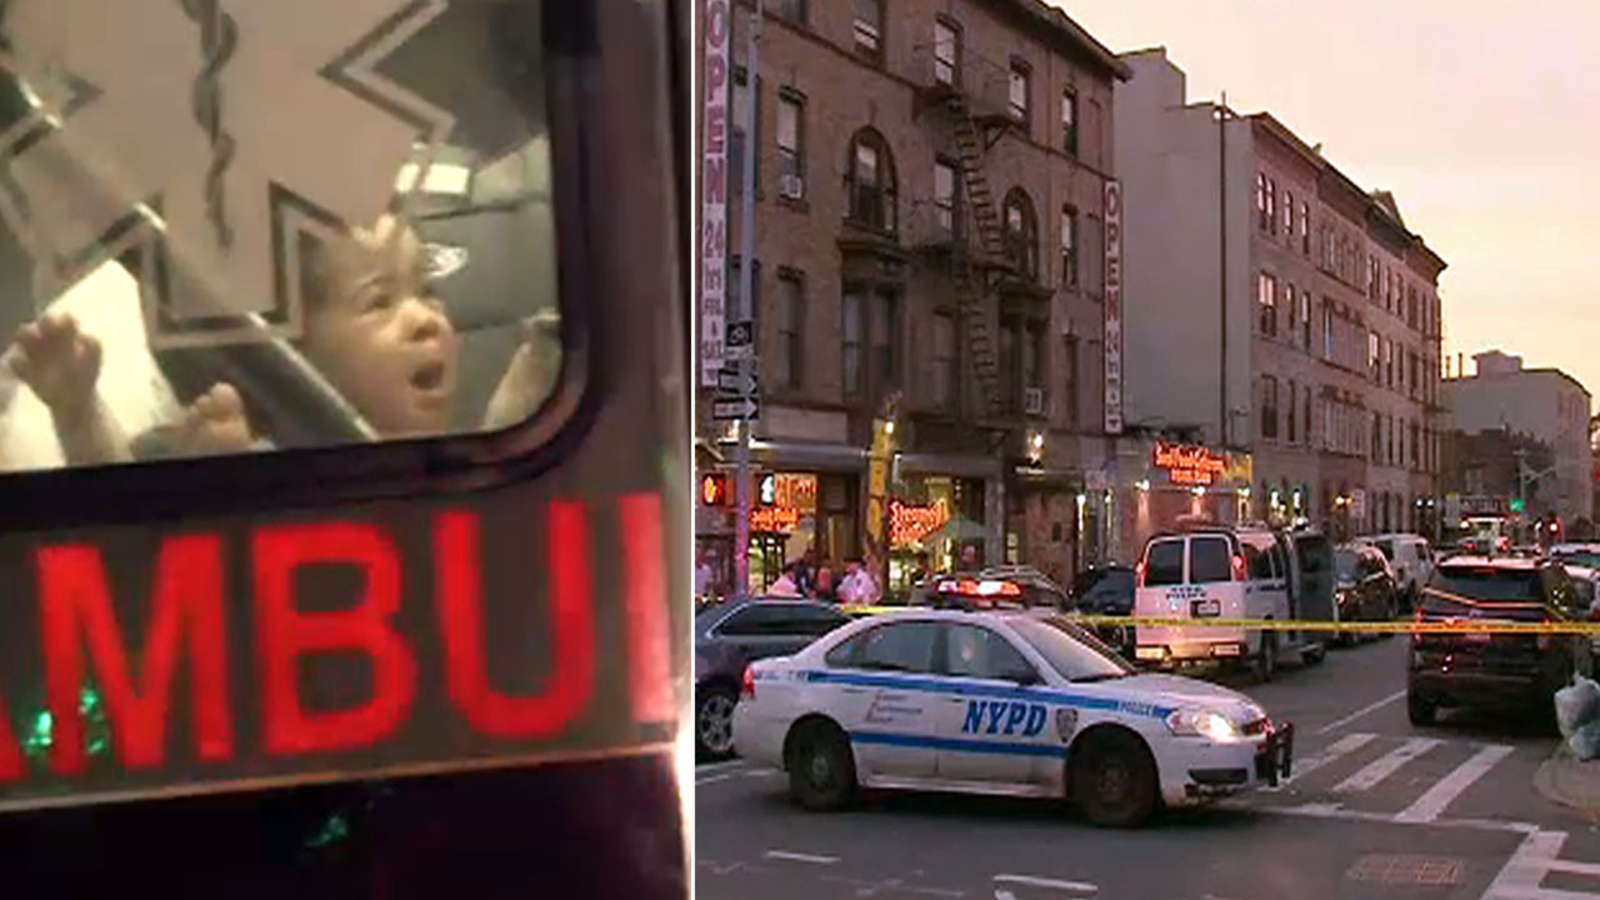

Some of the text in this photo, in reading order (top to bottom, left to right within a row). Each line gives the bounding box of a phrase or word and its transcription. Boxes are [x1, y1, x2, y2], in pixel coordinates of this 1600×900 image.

[705, 0, 728, 204] OPEN
[1105, 186, 1119, 322] OPEN
[961, 699, 1048, 737] NYPD
